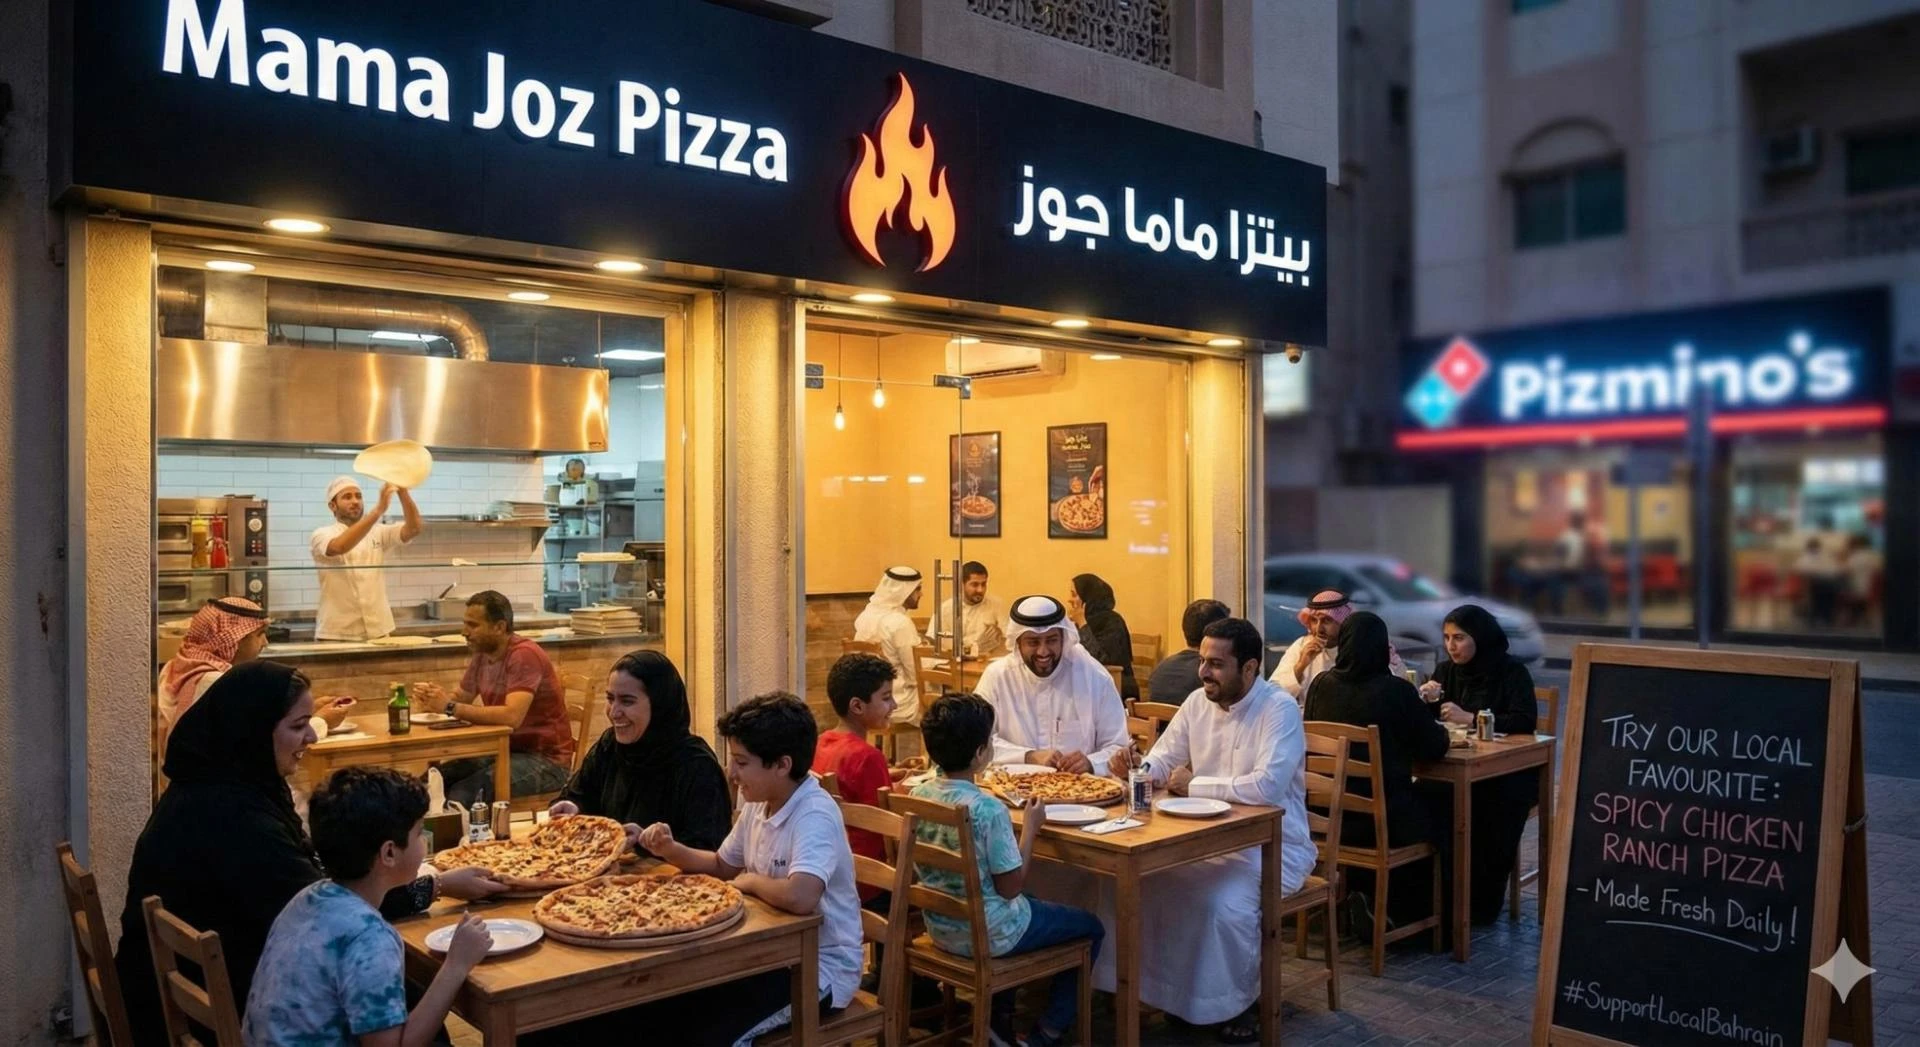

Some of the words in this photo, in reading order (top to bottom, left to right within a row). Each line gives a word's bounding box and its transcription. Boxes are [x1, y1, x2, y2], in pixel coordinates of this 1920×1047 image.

[162, 0, 450, 122] Mama
[473, 51, 595, 148] Joz
[619, 80, 788, 183] Pizza
[1013, 165, 1110, 250] جوز
[1125, 187, 1218, 261] ماما
[1230, 209, 1310, 287] بيتزا
[1500, 330, 1855, 420] Pizmino's
[1602, 714, 1657, 751] TRY
[1667, 726, 1719, 757] OUR
[1732, 730, 1813, 767] LOCAL
[1590, 792, 1673, 832] SPICY
[1683, 806, 1803, 852] CHICKEN
[1602, 833, 1688, 875] RANCH
[1703, 847, 1785, 890] PIZZA
[1661, 888, 1715, 924] Fresh
[1563, 980, 1784, 1047] #SupportLocalBahrain
